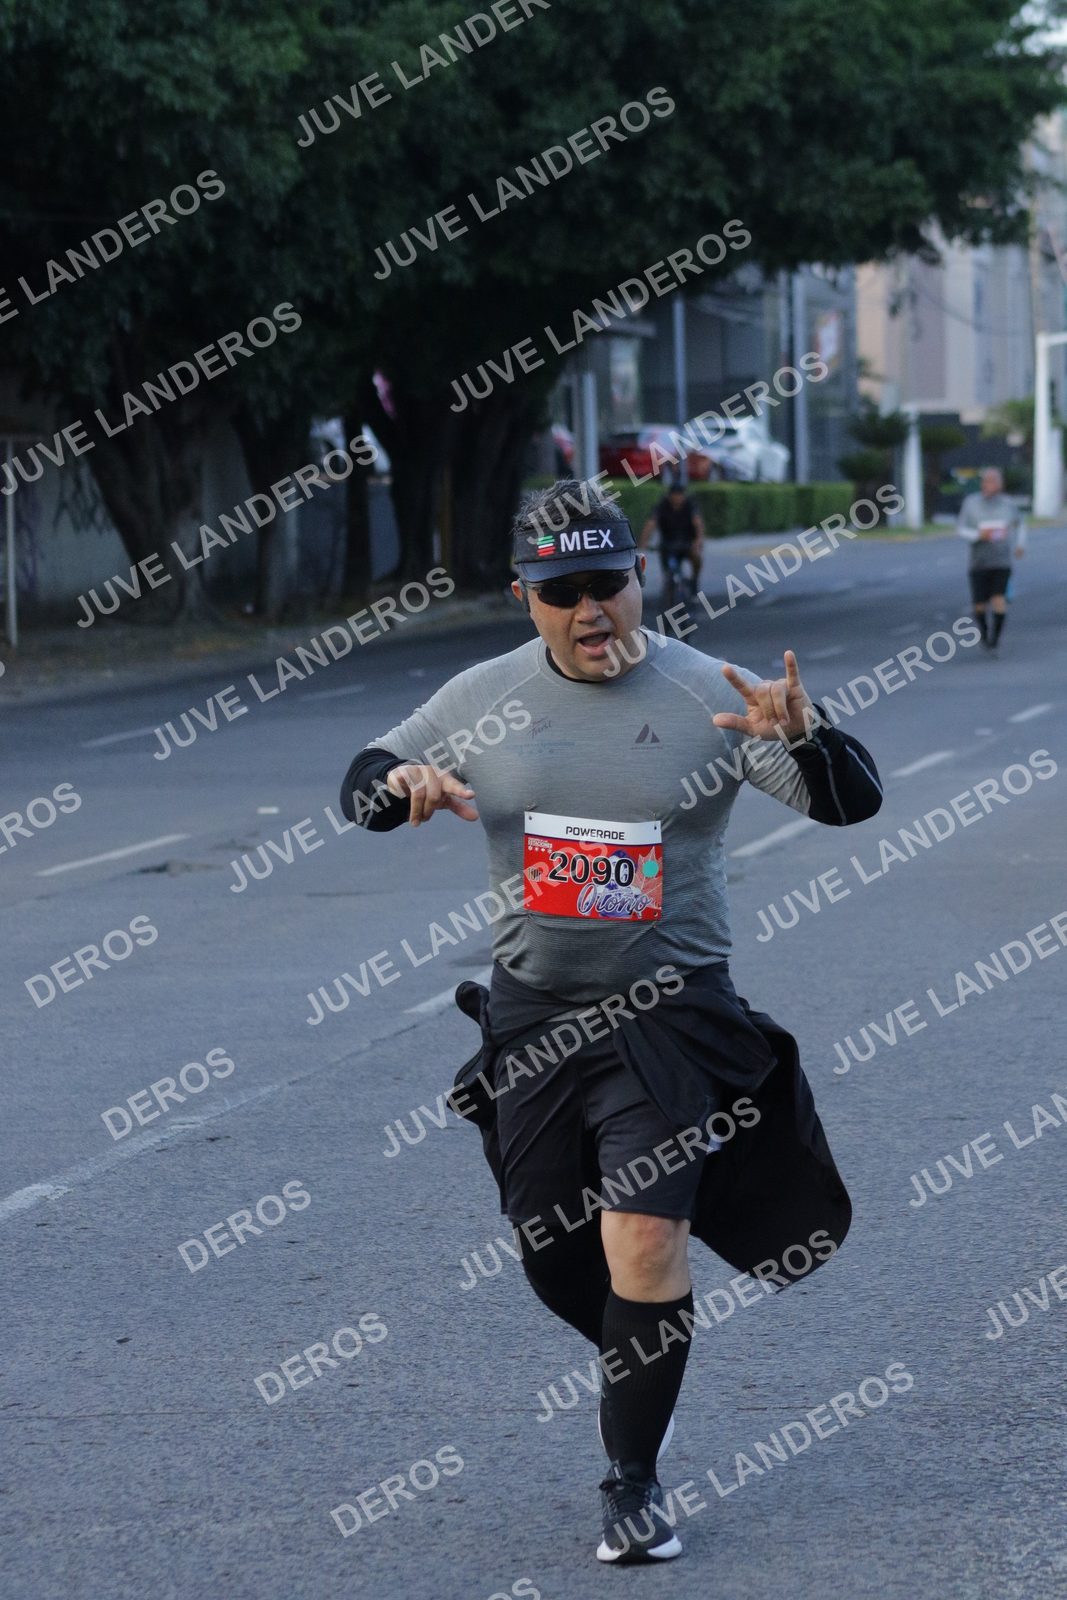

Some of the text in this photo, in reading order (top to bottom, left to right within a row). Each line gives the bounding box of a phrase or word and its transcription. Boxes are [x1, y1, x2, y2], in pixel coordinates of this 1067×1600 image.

[560, 529, 614, 552] MEX
[566, 826, 625, 840] POWERADE
[548, 851, 636, 887] 2090
